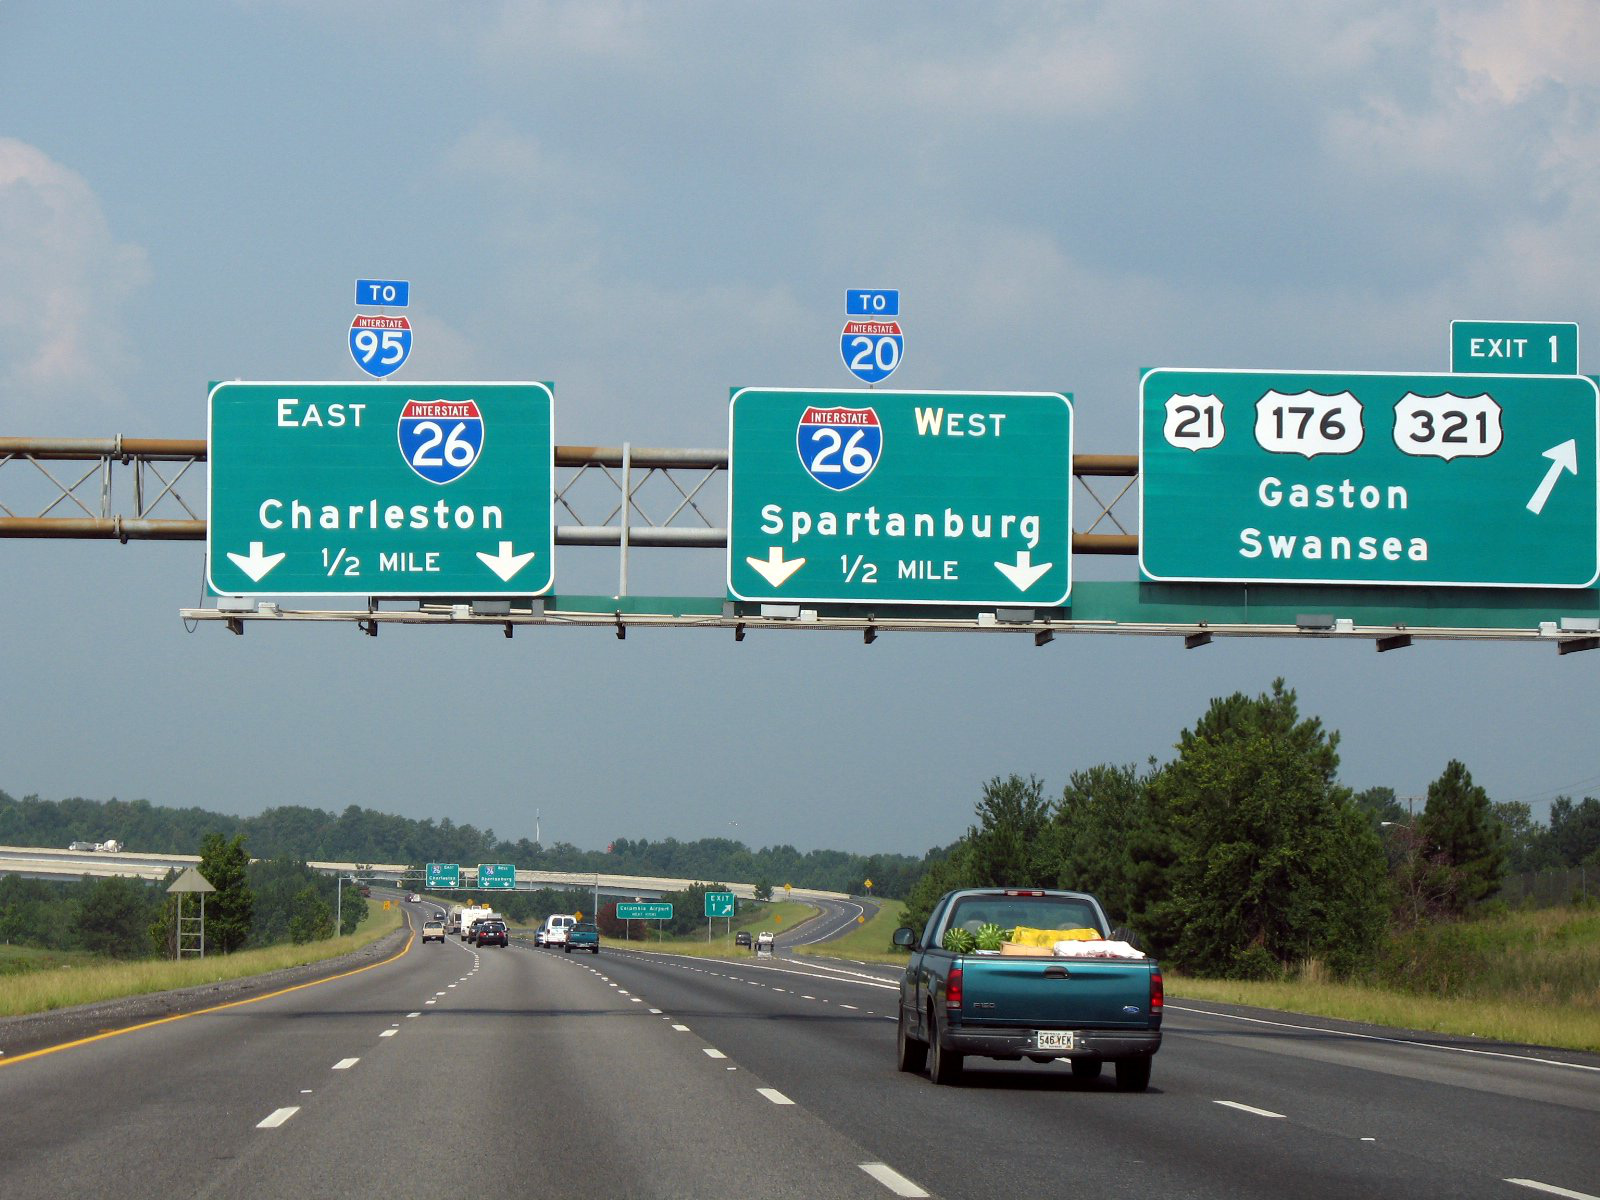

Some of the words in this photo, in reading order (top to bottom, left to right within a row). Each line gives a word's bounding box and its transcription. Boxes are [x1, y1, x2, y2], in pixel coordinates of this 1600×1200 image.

[369, 284, 396, 301] TO
[860, 294, 886, 310] TO
[359, 318, 403, 328] INTERSTATE
[850, 323, 894, 334] INTERSTATE
[355, 331, 404, 364] 95
[850, 336, 899, 371] 20
[1470, 338, 1528, 358] EXIT
[1549, 335, 1559, 363] 1
[411, 405, 470, 417] INTERSTATE
[811, 411, 869, 424] INTERSTATE
[1174, 405, 1214, 438] 21
[1272, 406, 1346, 441] 176
[1409, 410, 1488, 444] 321
[412, 421, 475, 467] 26
[810, 428, 873, 475] 26
[1258, 476, 1408, 510] Gaston
[258, 498, 502, 529] Charleston
[760, 504, 1040, 549] Spartanburg
[1238, 527, 1429, 562] Swansea
[379, 552, 441, 573] MILE
[898, 560, 958, 580] MILE
[711, 903, 716, 912] 1
[1039, 1035, 1055, 1045] 546
